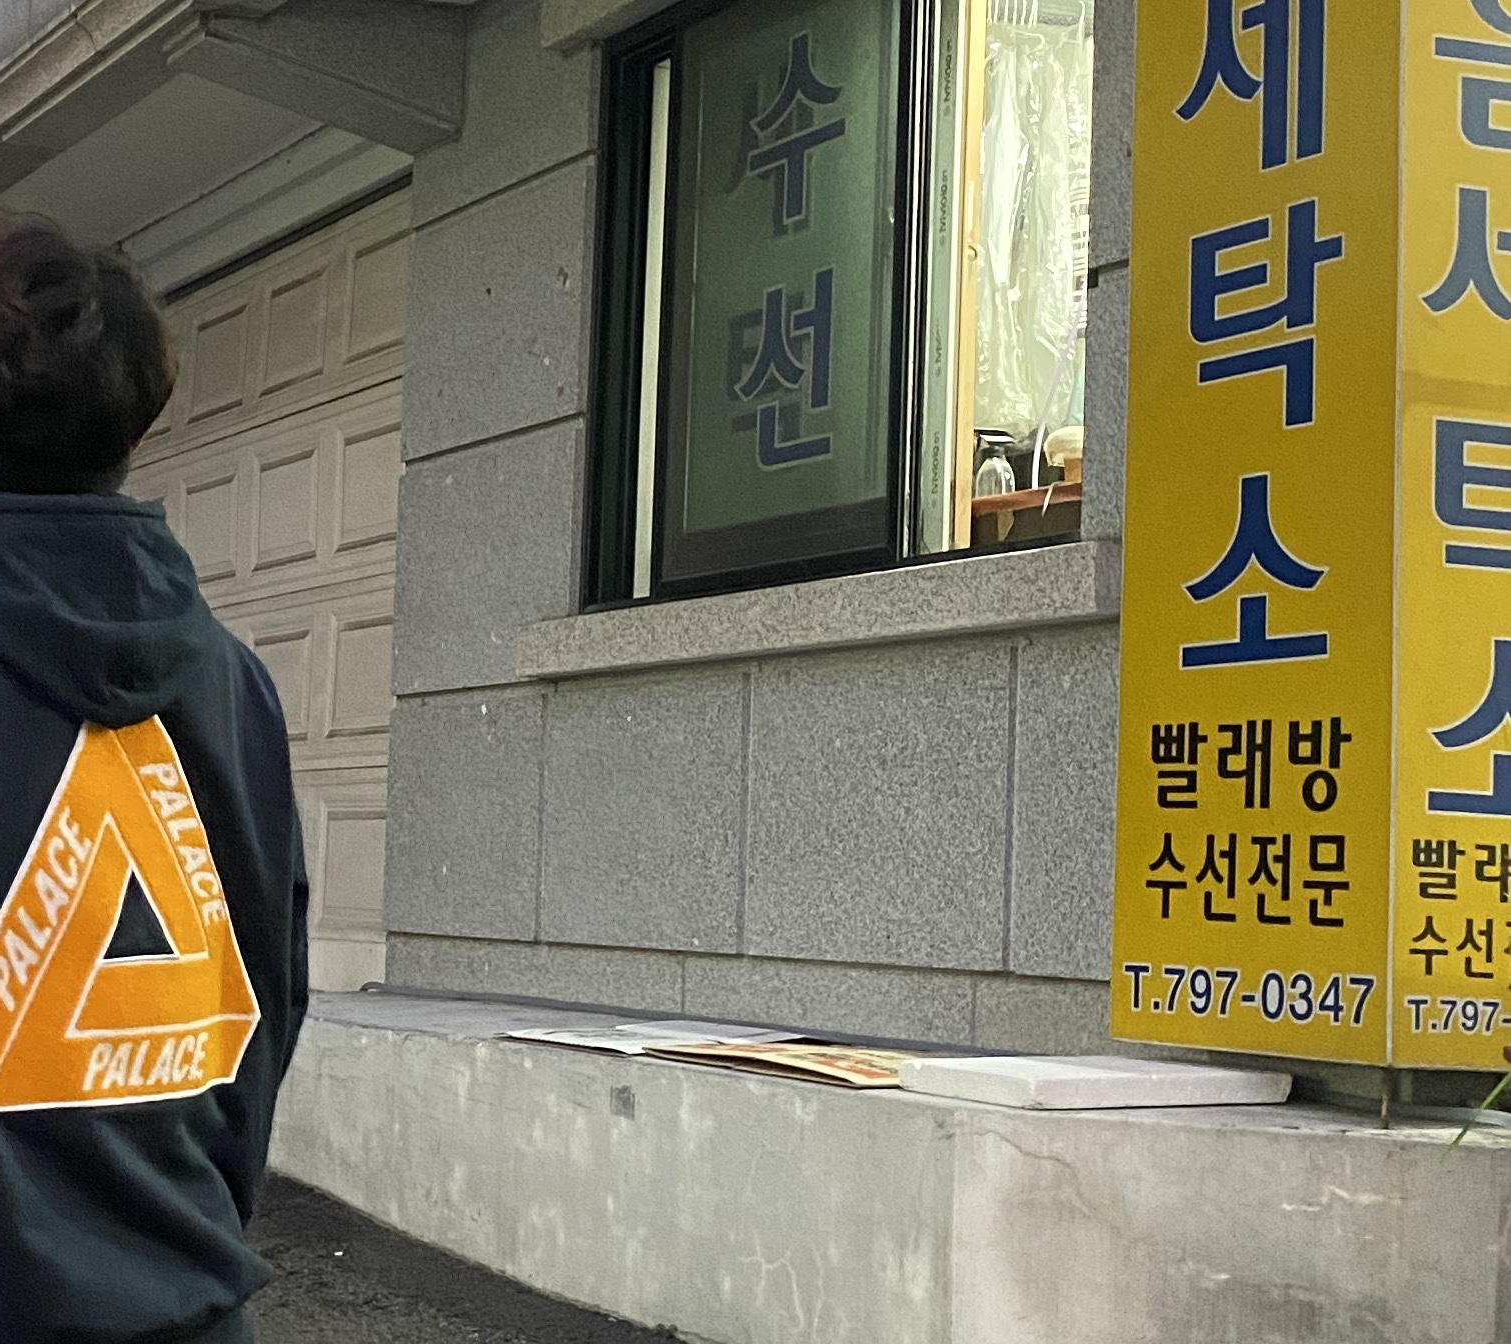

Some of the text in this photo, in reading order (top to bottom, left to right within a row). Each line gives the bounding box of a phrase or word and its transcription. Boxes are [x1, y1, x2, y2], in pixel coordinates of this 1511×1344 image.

[733, 30, 847, 473] 수선
[1150, 716, 1353, 812] 빨래방
[138, 761, 229, 928] PALACE
[1145, 832, 1350, 928] 수선전문
[1124, 963, 1376, 1027] T.797-0347
[1408, 915, 1511, 989] 수선
[81, 1031, 210, 1092] PALACE
